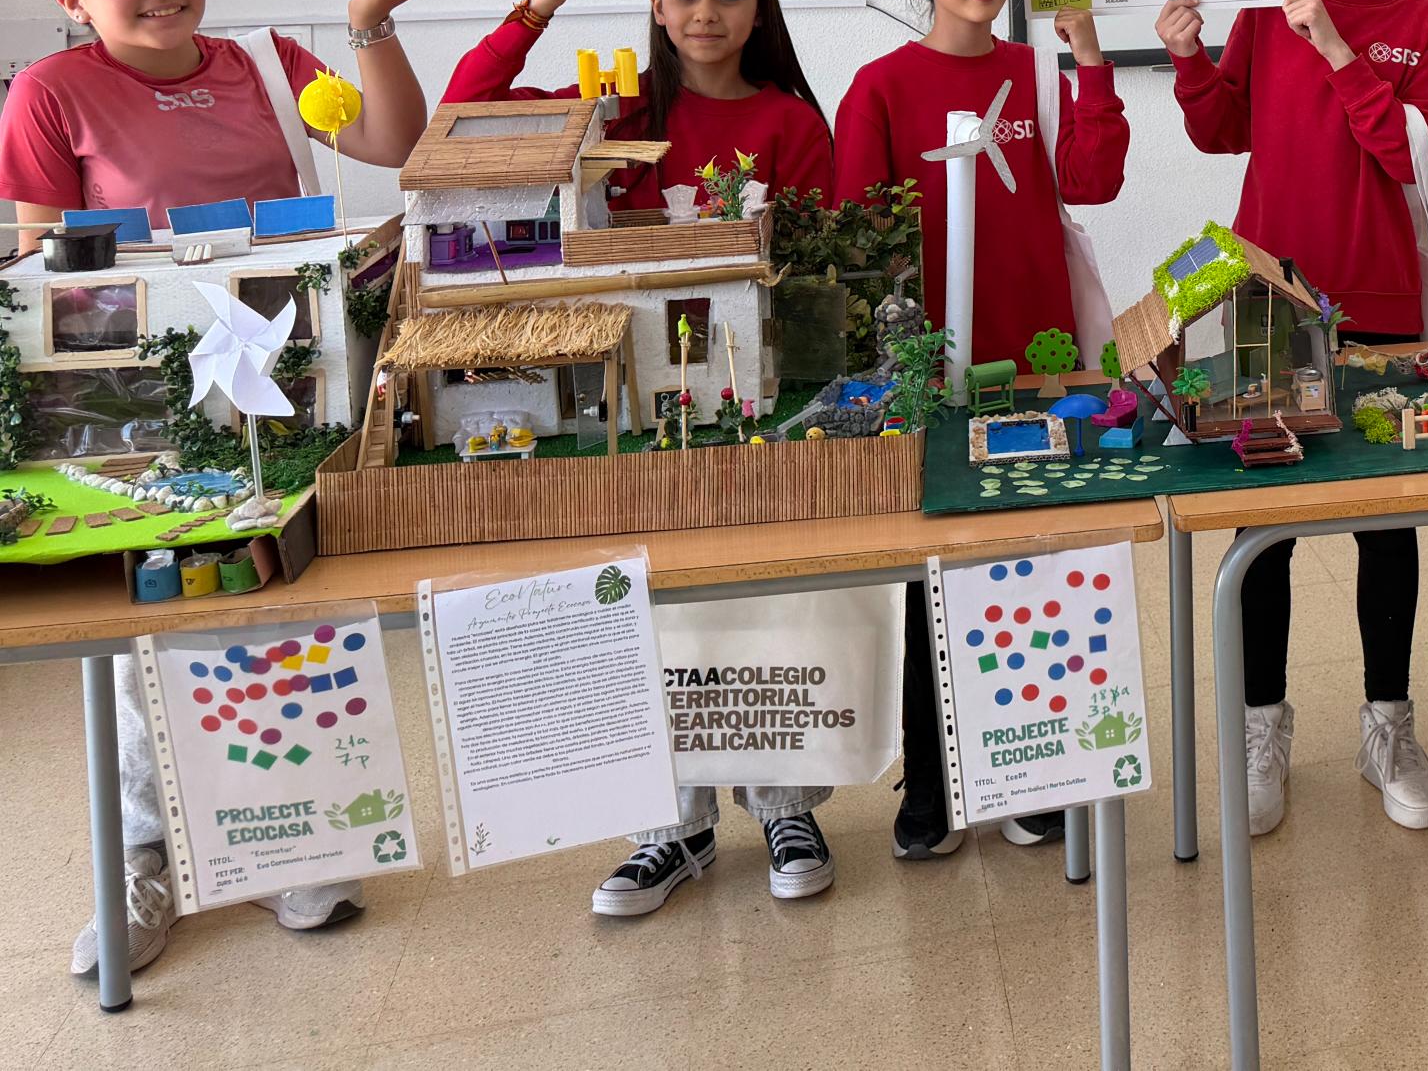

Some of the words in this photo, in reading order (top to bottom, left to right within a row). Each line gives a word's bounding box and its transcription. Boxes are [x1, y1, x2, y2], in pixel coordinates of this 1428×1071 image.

[1013, 119, 1035, 140] SD
[667, 688, 815, 710] ERRITORIAL
[670, 709, 856, 732] EARQUITECTOS
[982, 717, 1070, 747] PROJECTE
[674, 732, 804, 752] EALICANTE
[990, 739, 1065, 768] ECOCASA
[215, 800, 317, 826] PROJECTE
[227, 820, 314, 846] ECOCASA
